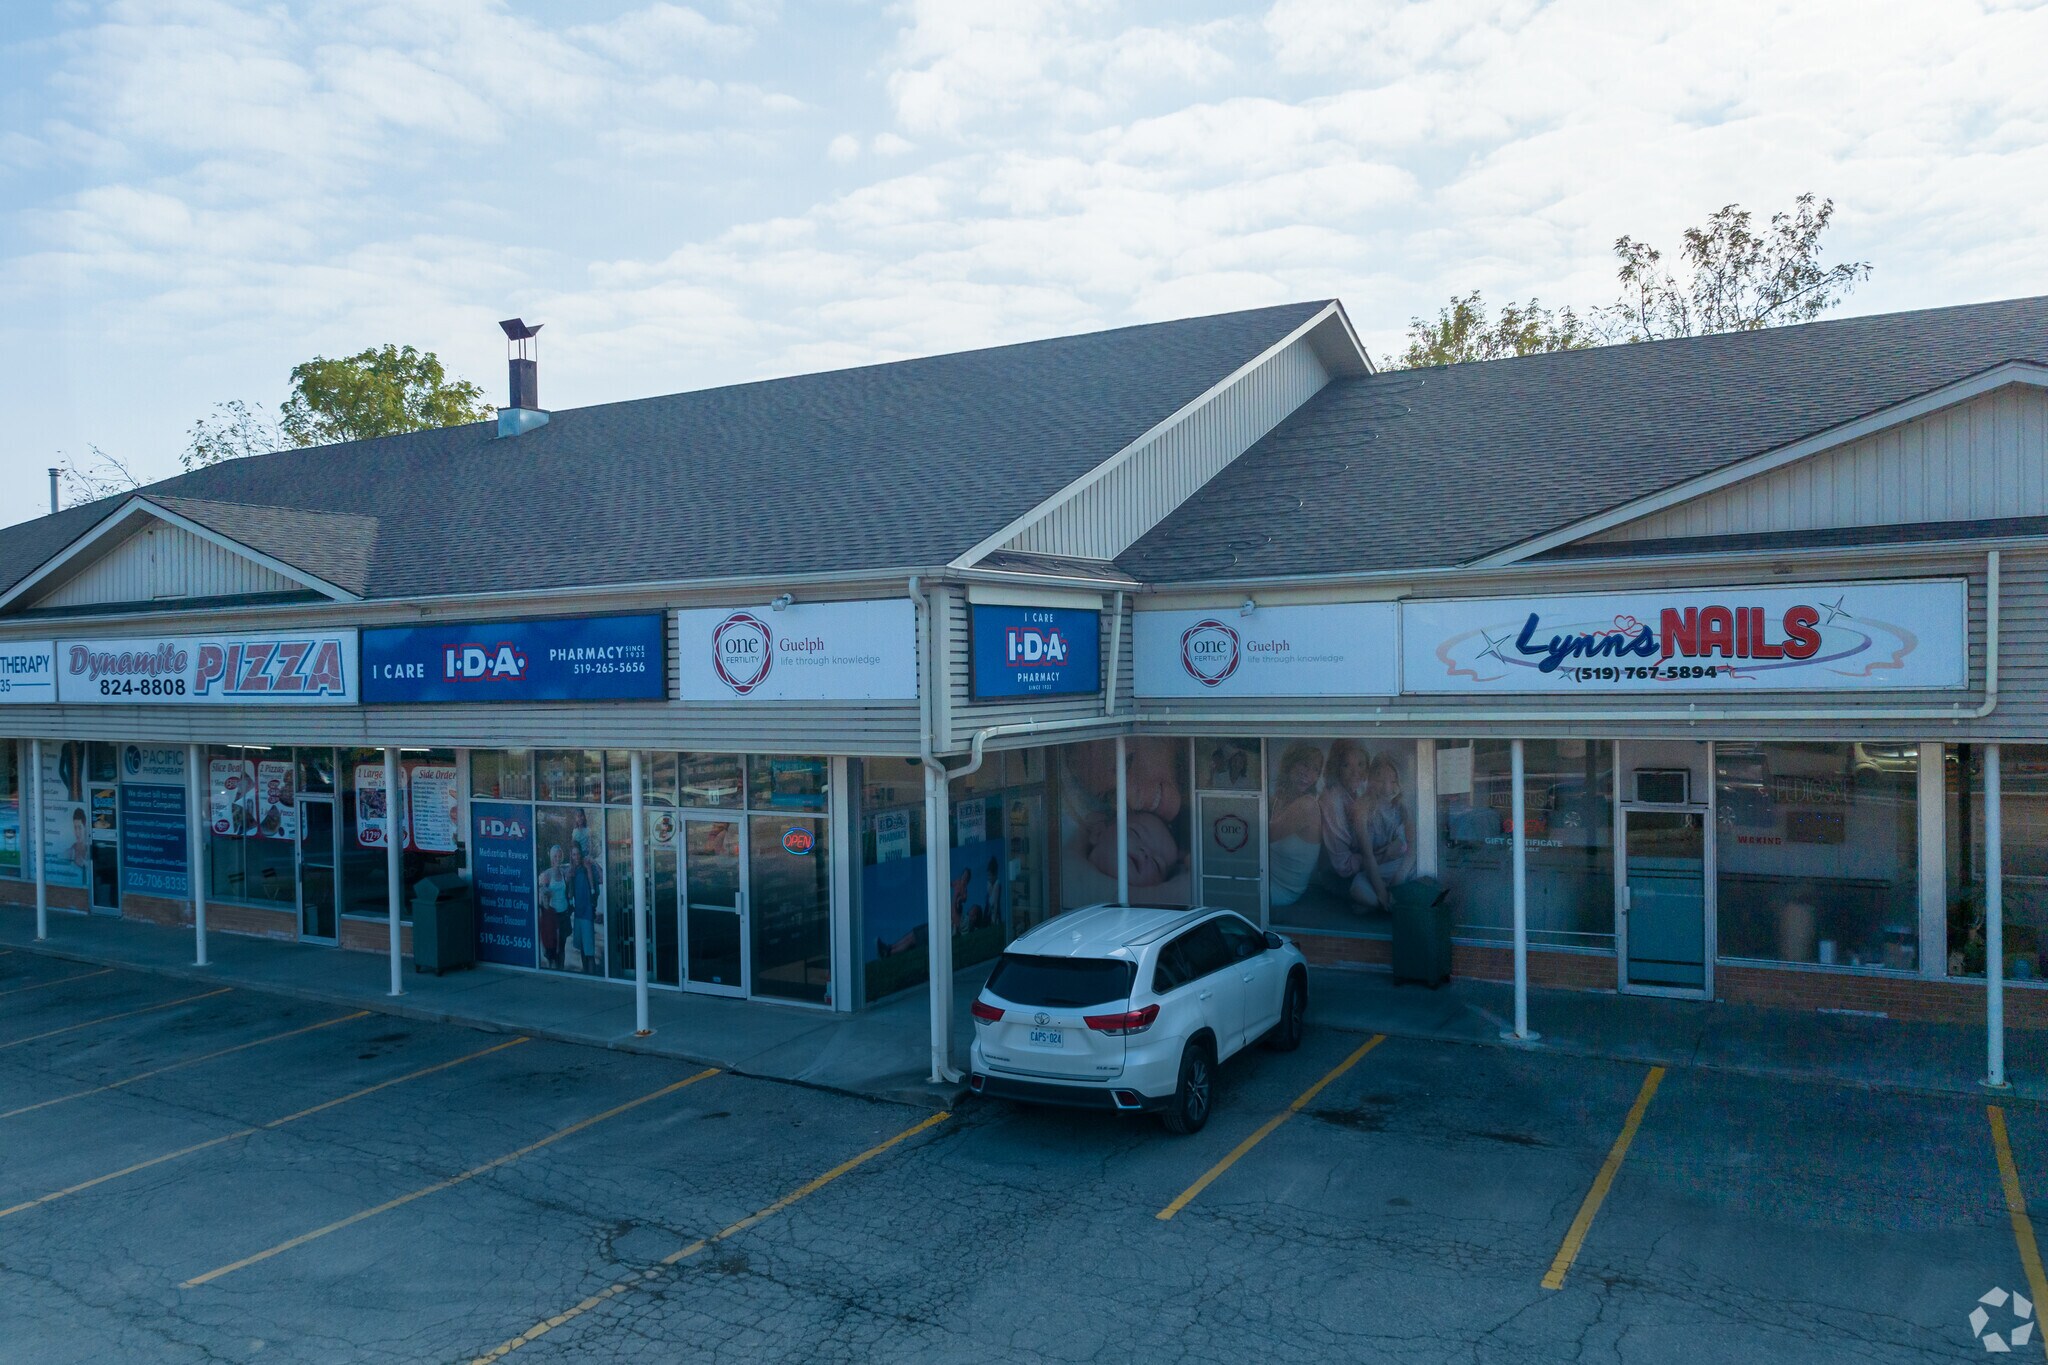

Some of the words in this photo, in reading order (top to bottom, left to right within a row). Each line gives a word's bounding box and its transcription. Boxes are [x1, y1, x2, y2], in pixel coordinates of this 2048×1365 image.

[1032, 613, 1053, 622] CARE
[725, 637, 759, 653] one
[779, 637, 824, 654] Guelph
[1194, 640, 1226, 653] one
[1516, 612, 1660, 673] Lynns
[1660, 605, 1822, 660] NAILS
[549, 646, 624, 661] PHARMACY
[1247, 640, 1290, 654] Guelph
[69, 642, 188, 681] Dynamite
[726, 656, 759, 664] FERTILITY
[780, 656, 793, 666] life
[796, 656, 829, 666] through
[832, 655, 880, 665] knowledge
[1247, 656, 1259, 664] life
[1262, 655, 1294, 664] through
[1297, 654, 1344, 664] knowledge
[193, 640, 346, 697] PIZZA
[384, 663, 424, 679] CARE
[574, 662, 645, 674] 519-265-5656
[1575, 666, 1620, 682] (519)
[1626, 665, 1718, 679] 767-5894
[1017, 672, 1060, 682] PHARMACY
[100, 679, 186, 696] 824-8808
[142, 749, 184, 766] PACIFIC
[363, 769, 383, 779] Large
[418, 769, 434, 780] Side
[1220, 823, 1241, 834] one
[783, 834, 812, 849] OPEN
[1485, 837, 1505, 845] GIFT
[127, 872, 187, 891] 226-706-8335
[480, 932, 532, 949] 519-265-5656
